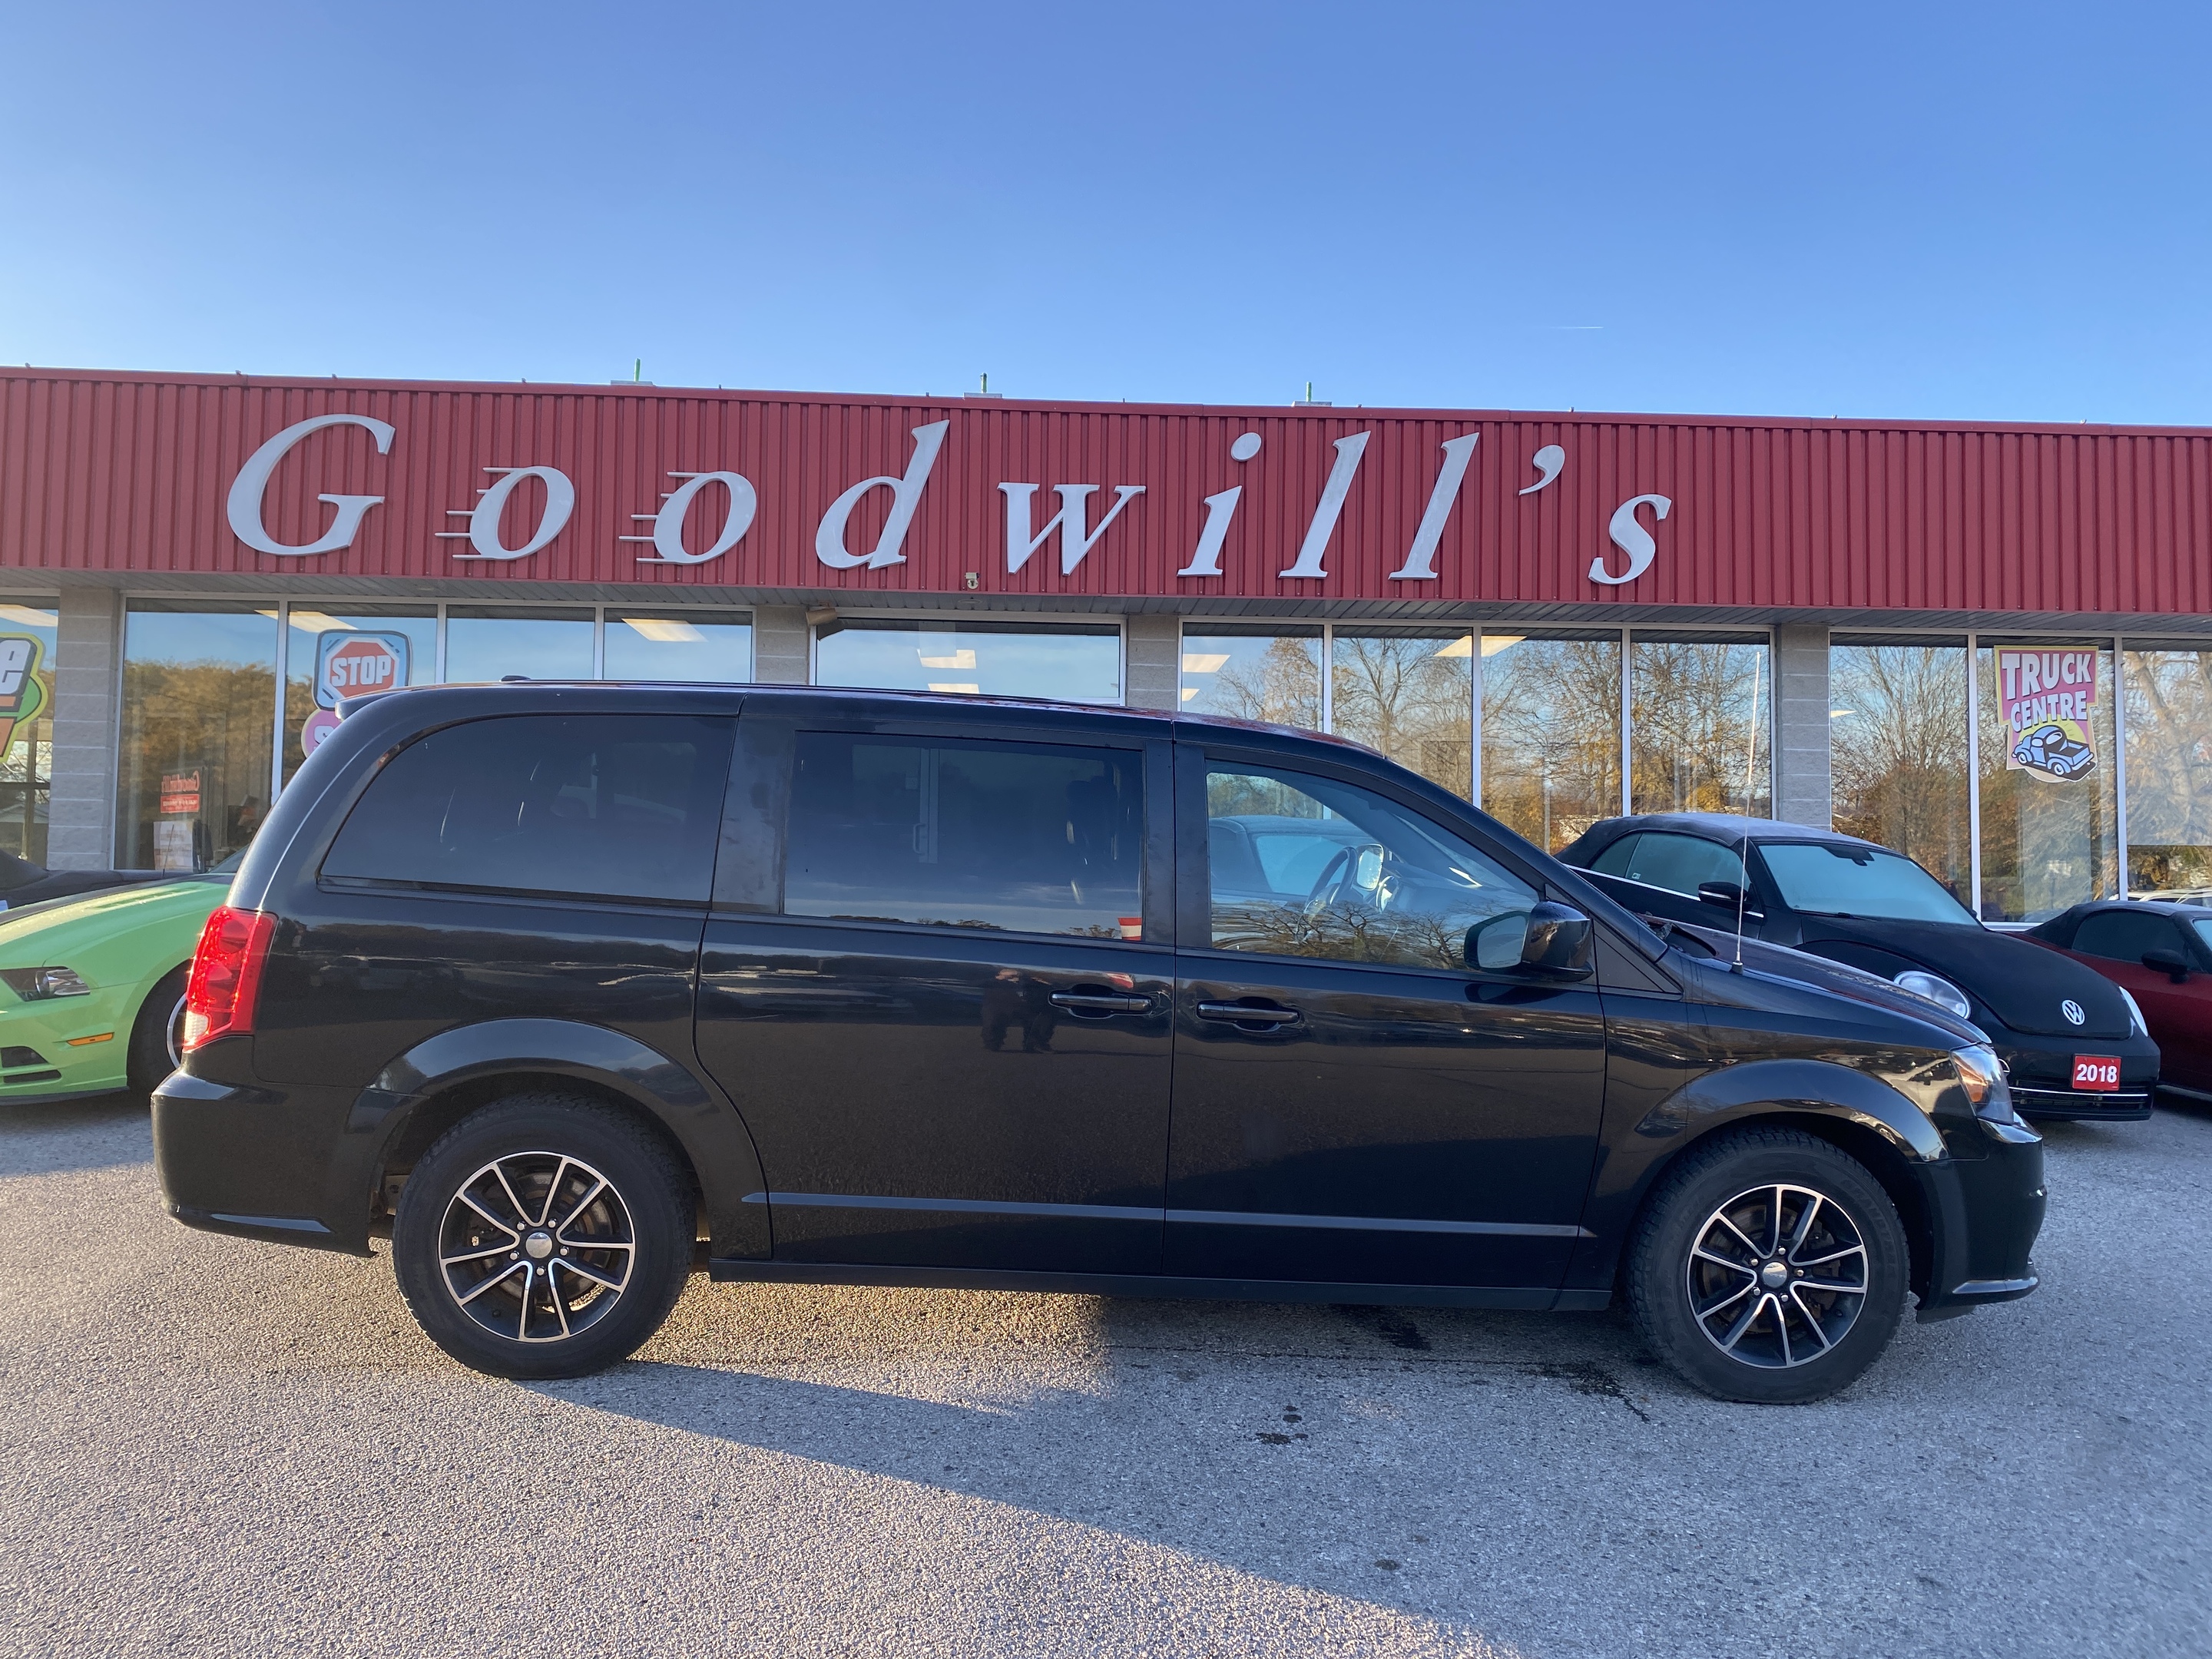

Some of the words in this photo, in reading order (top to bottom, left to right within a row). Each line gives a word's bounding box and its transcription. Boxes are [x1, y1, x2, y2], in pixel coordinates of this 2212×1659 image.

[227, 413, 1672, 585] Goodwill's
[331, 655, 392, 687] STOP
[2002, 653, 2092, 700] TRUCK
[2011, 690, 2088, 733] CENTRE
[2076, 1064, 2118, 1083] 2018
